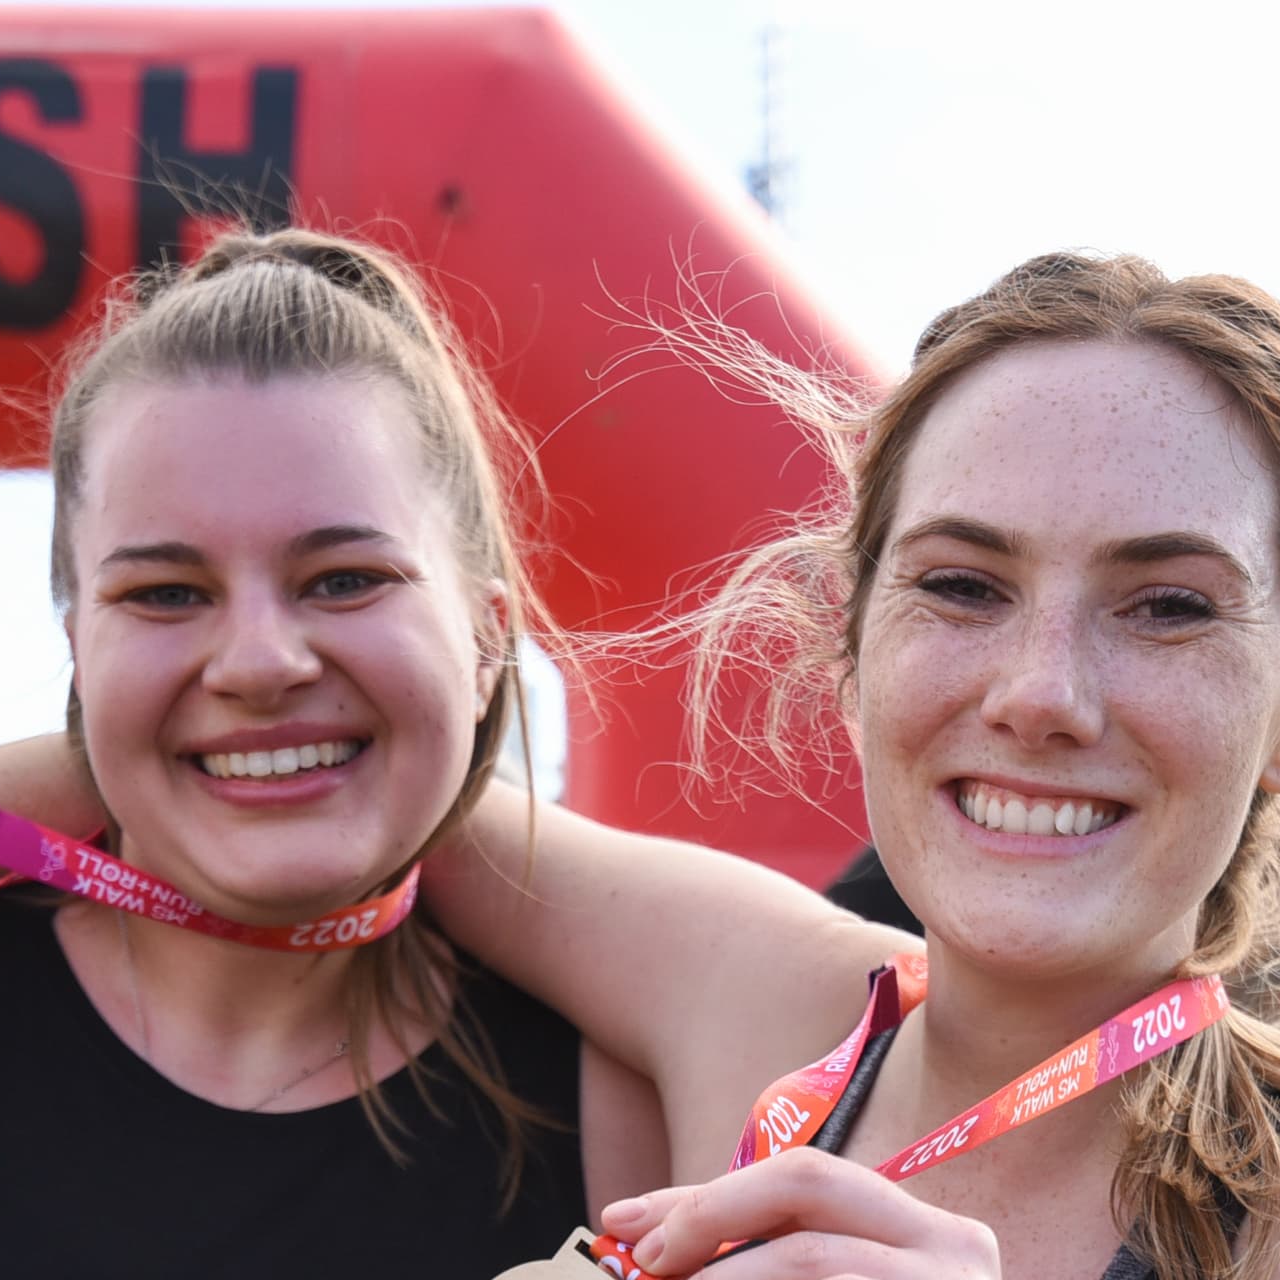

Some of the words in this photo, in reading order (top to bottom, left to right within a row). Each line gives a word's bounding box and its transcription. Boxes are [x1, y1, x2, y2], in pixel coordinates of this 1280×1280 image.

[72, 873, 145, 914] WALK
[150, 903, 189, 925] MS
[289, 908, 379, 947] 2022
[1132, 994, 1186, 1053] 2022
[1010, 1085, 1055, 1125] WALK
[1057, 1074, 1081, 1101] MS
[759, 1095, 810, 1157] 2022
[900, 1114, 979, 1173] 2022
